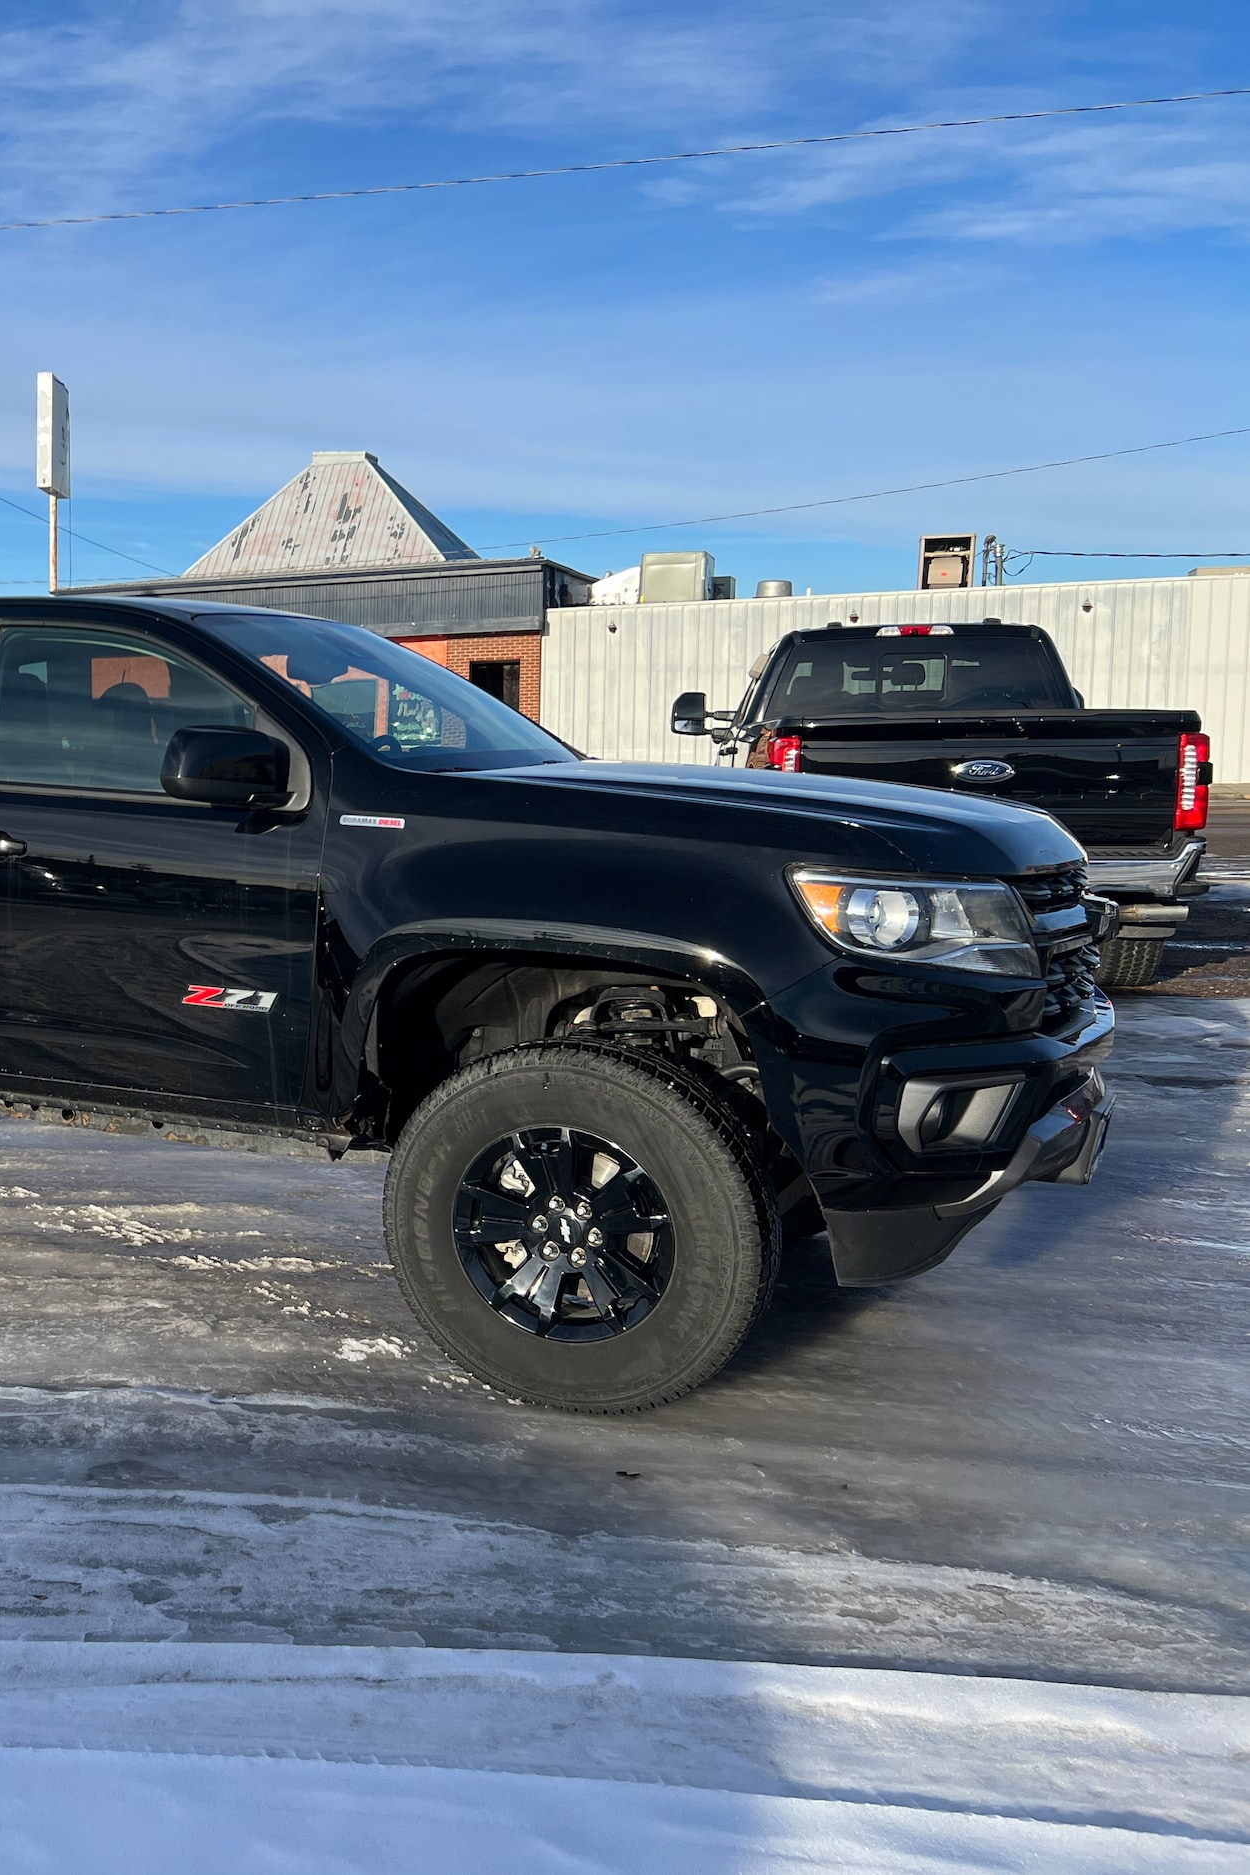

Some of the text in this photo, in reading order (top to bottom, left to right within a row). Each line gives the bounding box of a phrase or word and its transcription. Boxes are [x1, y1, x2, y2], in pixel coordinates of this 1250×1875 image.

[968, 764, 1000, 776] Ford
[342, 817, 402, 827] DURAMAX DIESEL
[182, 984, 278, 1012] Z71
